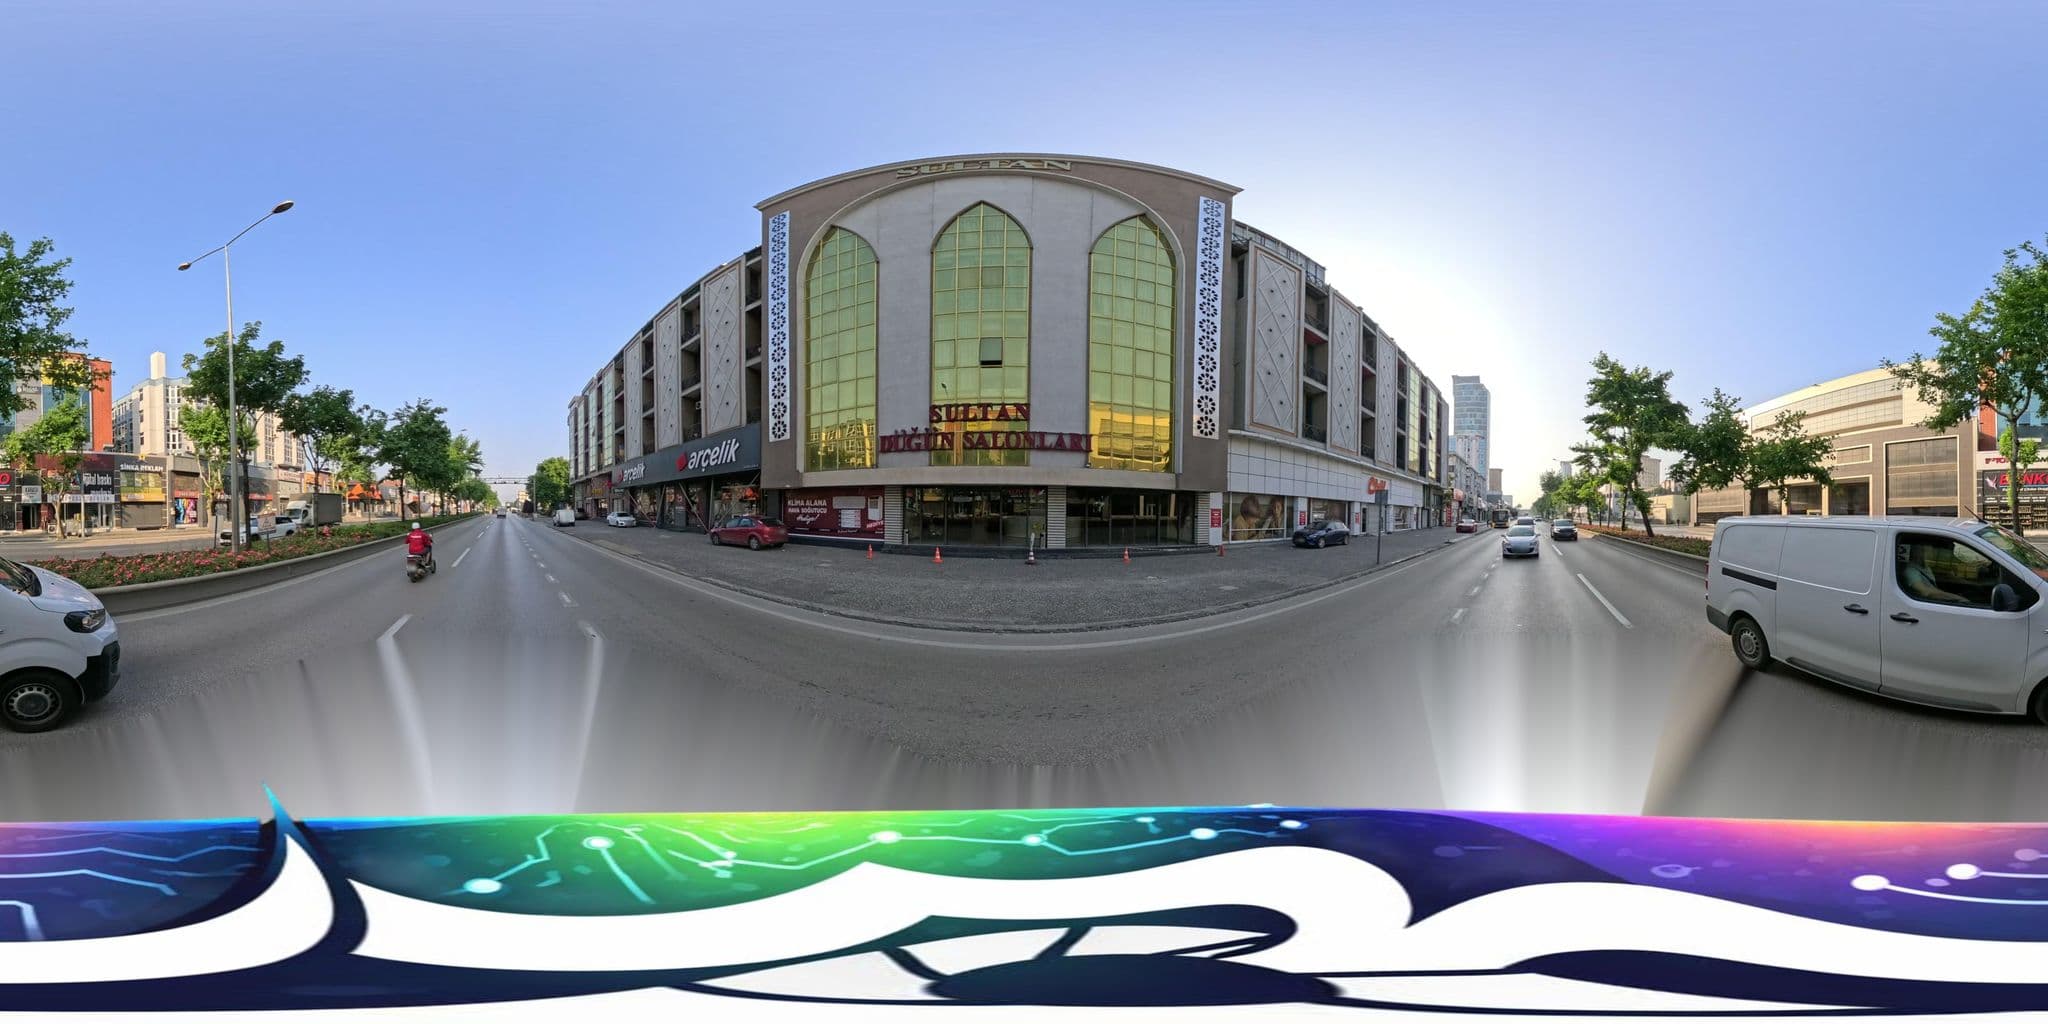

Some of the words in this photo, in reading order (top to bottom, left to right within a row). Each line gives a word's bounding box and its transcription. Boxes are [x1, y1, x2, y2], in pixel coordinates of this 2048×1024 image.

[896, 160, 1072, 178] SULTAN
[930, 404, 1030, 421] SULTAN
[963, 431, 1093, 452] SALONLARI
[688, 439, 739, 472] arçelik
[622, 463, 646, 483] arçelik
